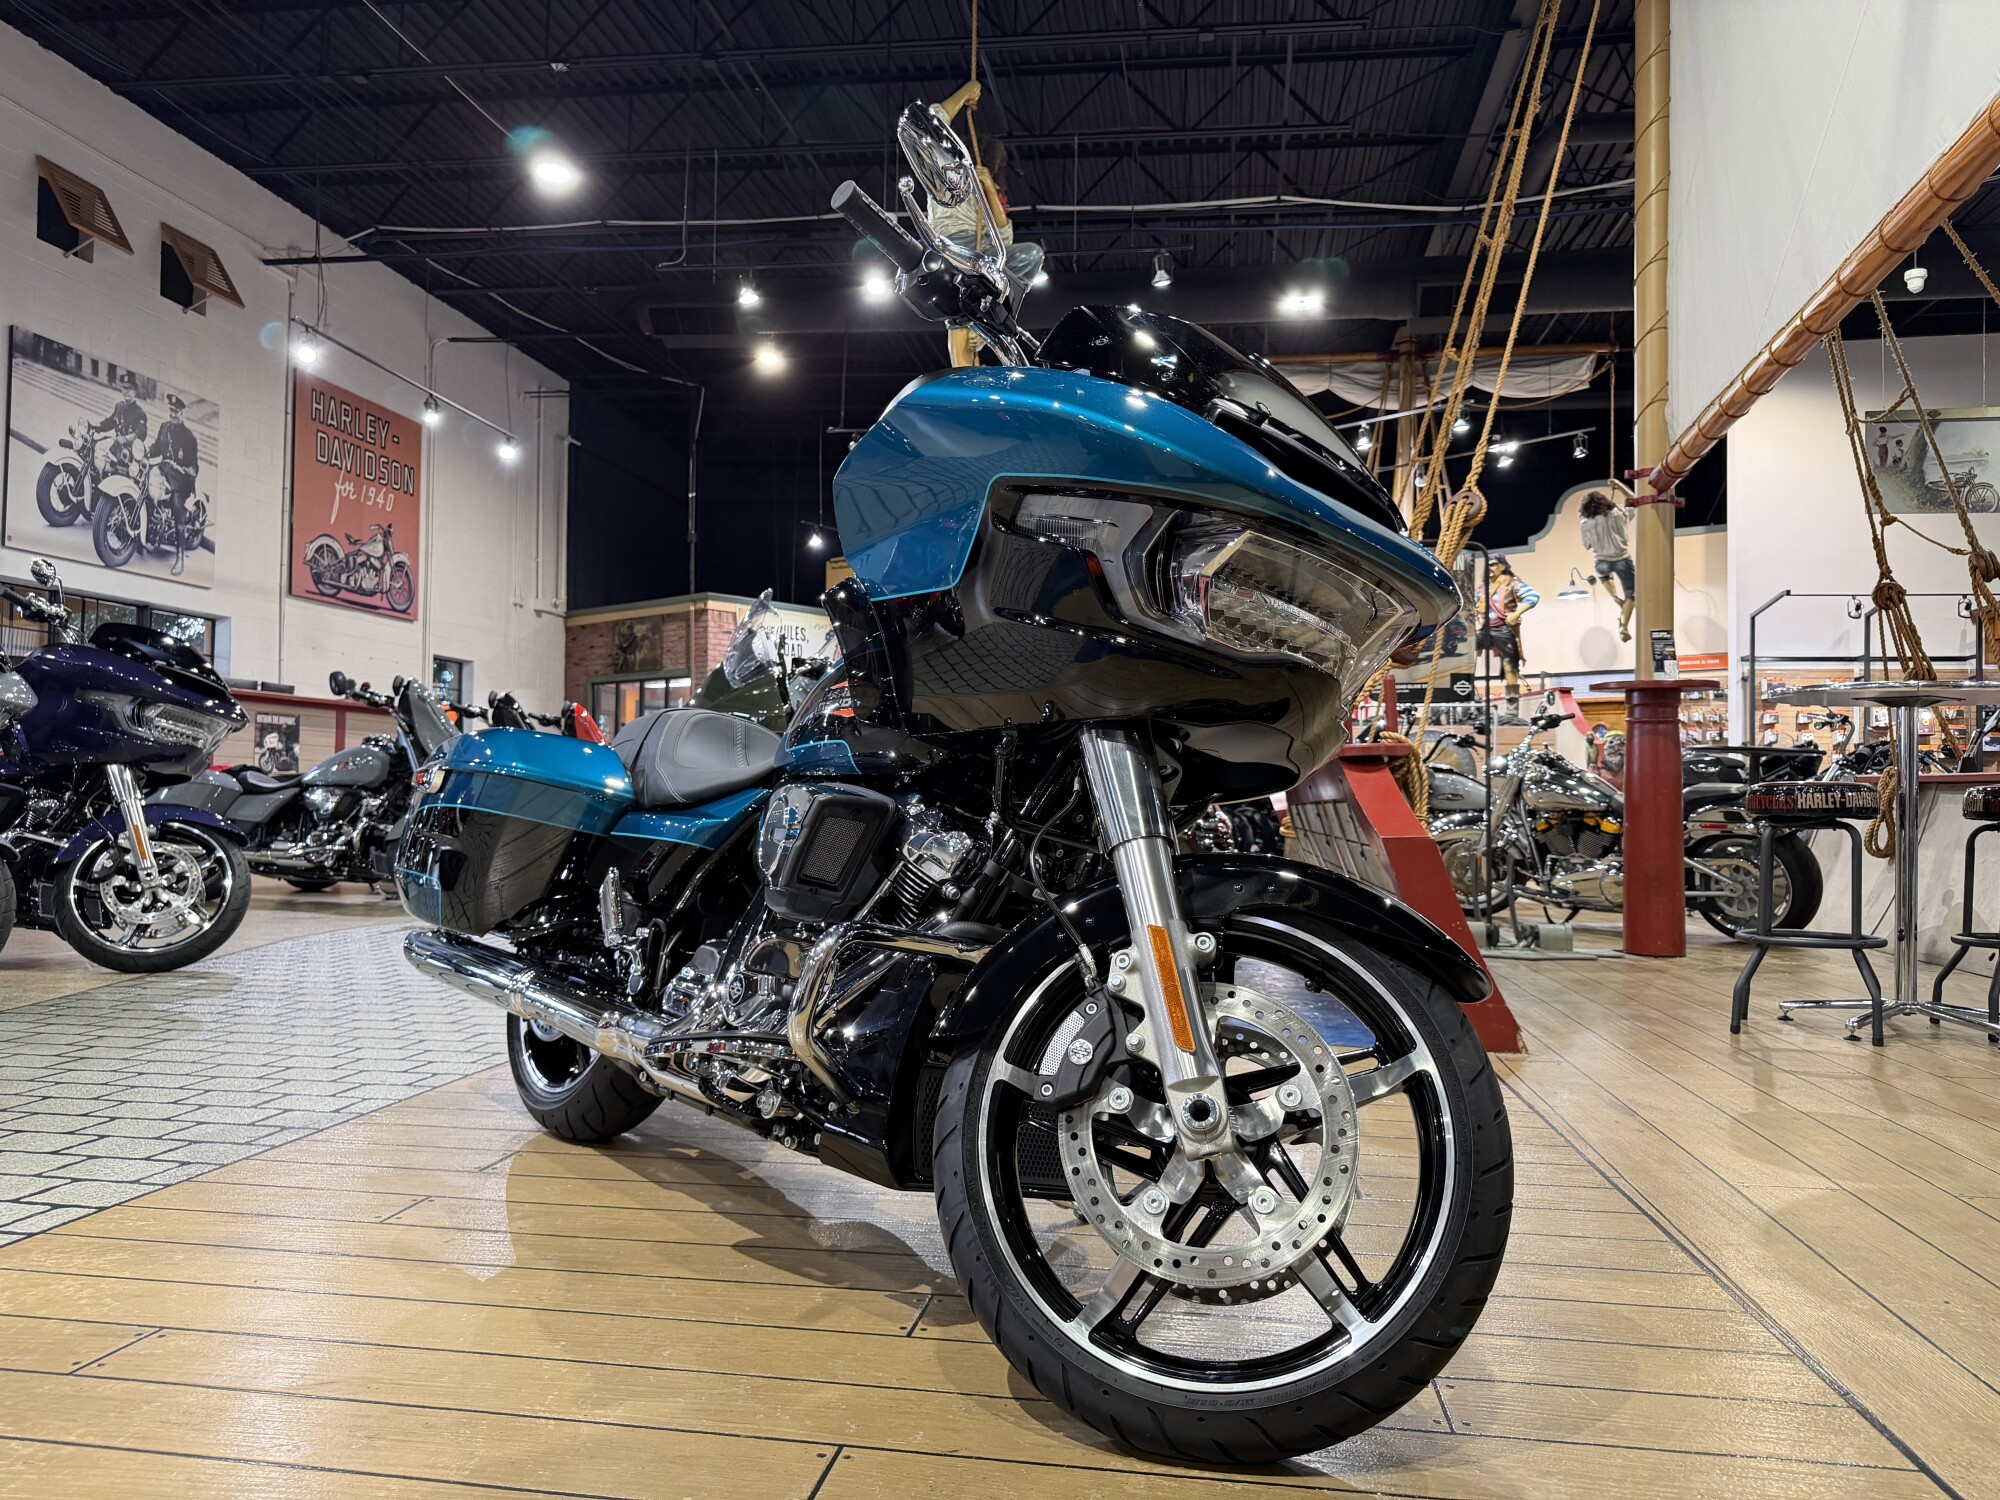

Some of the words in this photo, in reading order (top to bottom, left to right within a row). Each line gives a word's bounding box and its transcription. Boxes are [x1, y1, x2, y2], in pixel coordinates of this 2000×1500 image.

[311, 388, 400, 450] HARLEY-
[316, 429, 415, 497] DAVIDSON
[330, 459, 357, 525] for
[360, 484, 395, 512] 1940
